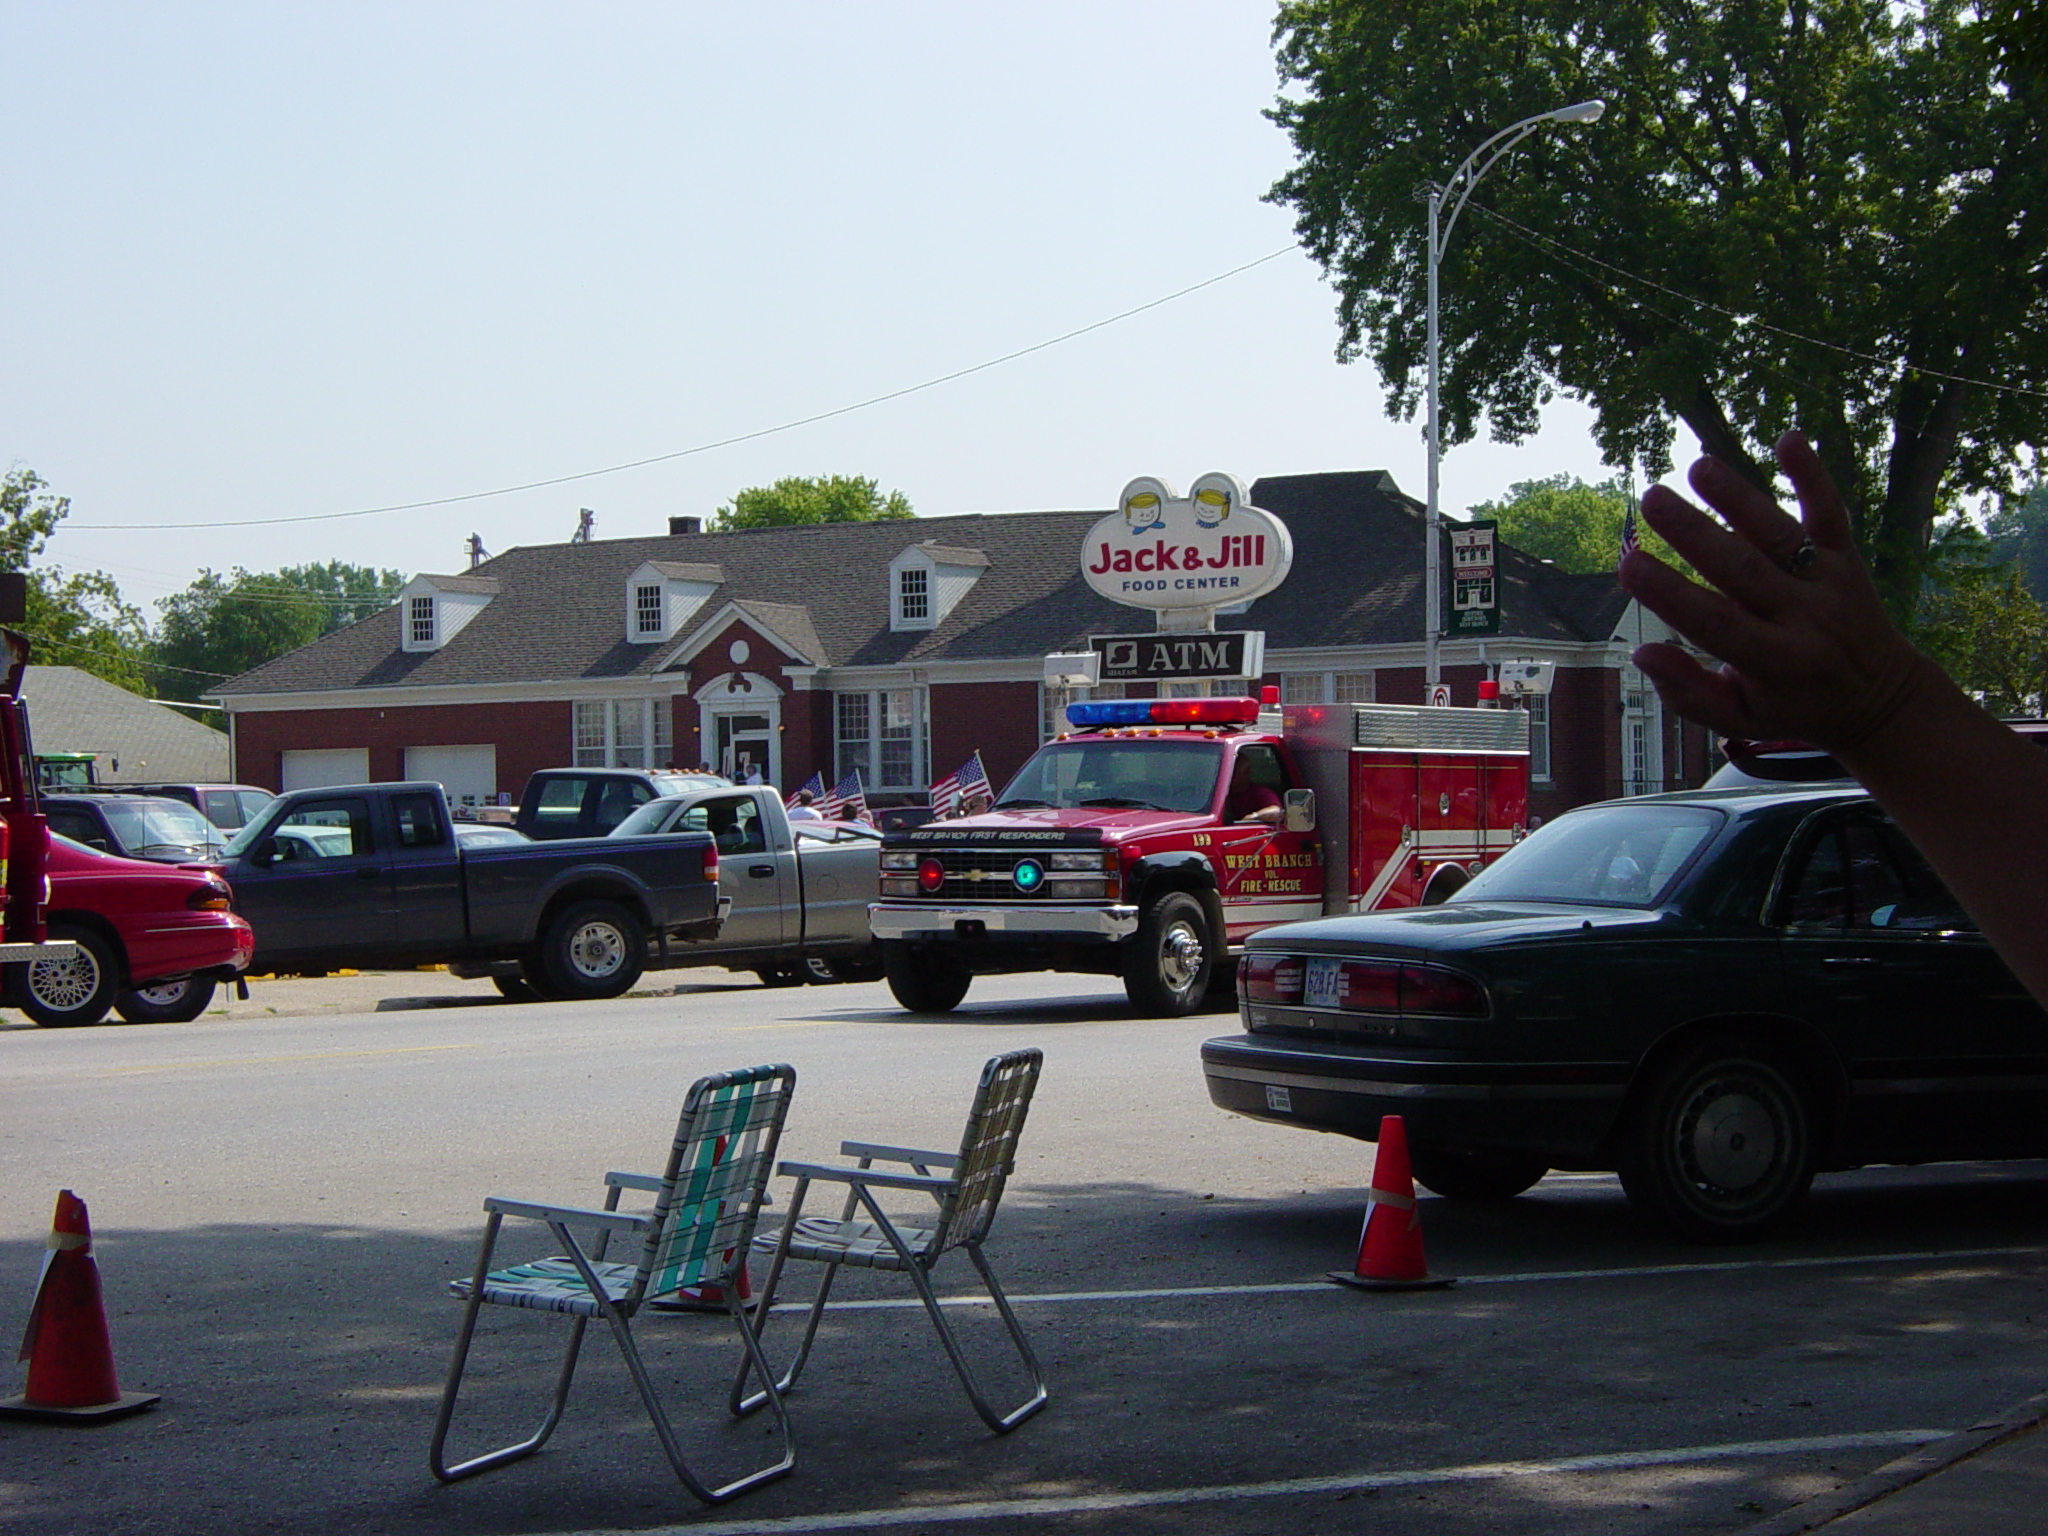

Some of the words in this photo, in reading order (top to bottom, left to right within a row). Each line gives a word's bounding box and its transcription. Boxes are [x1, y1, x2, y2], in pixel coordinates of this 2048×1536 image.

[1122, 578, 1167, 592] FOOD
[1174, 576, 1240, 590] CENTER
[1147, 640, 1230, 671] ATM
[969, 831, 998, 840] FIRST
[998, 831, 1066, 840] RESPONDERS
[1224, 854, 1261, 869] WEST
[1264, 854, 1312, 868] BRANCH
